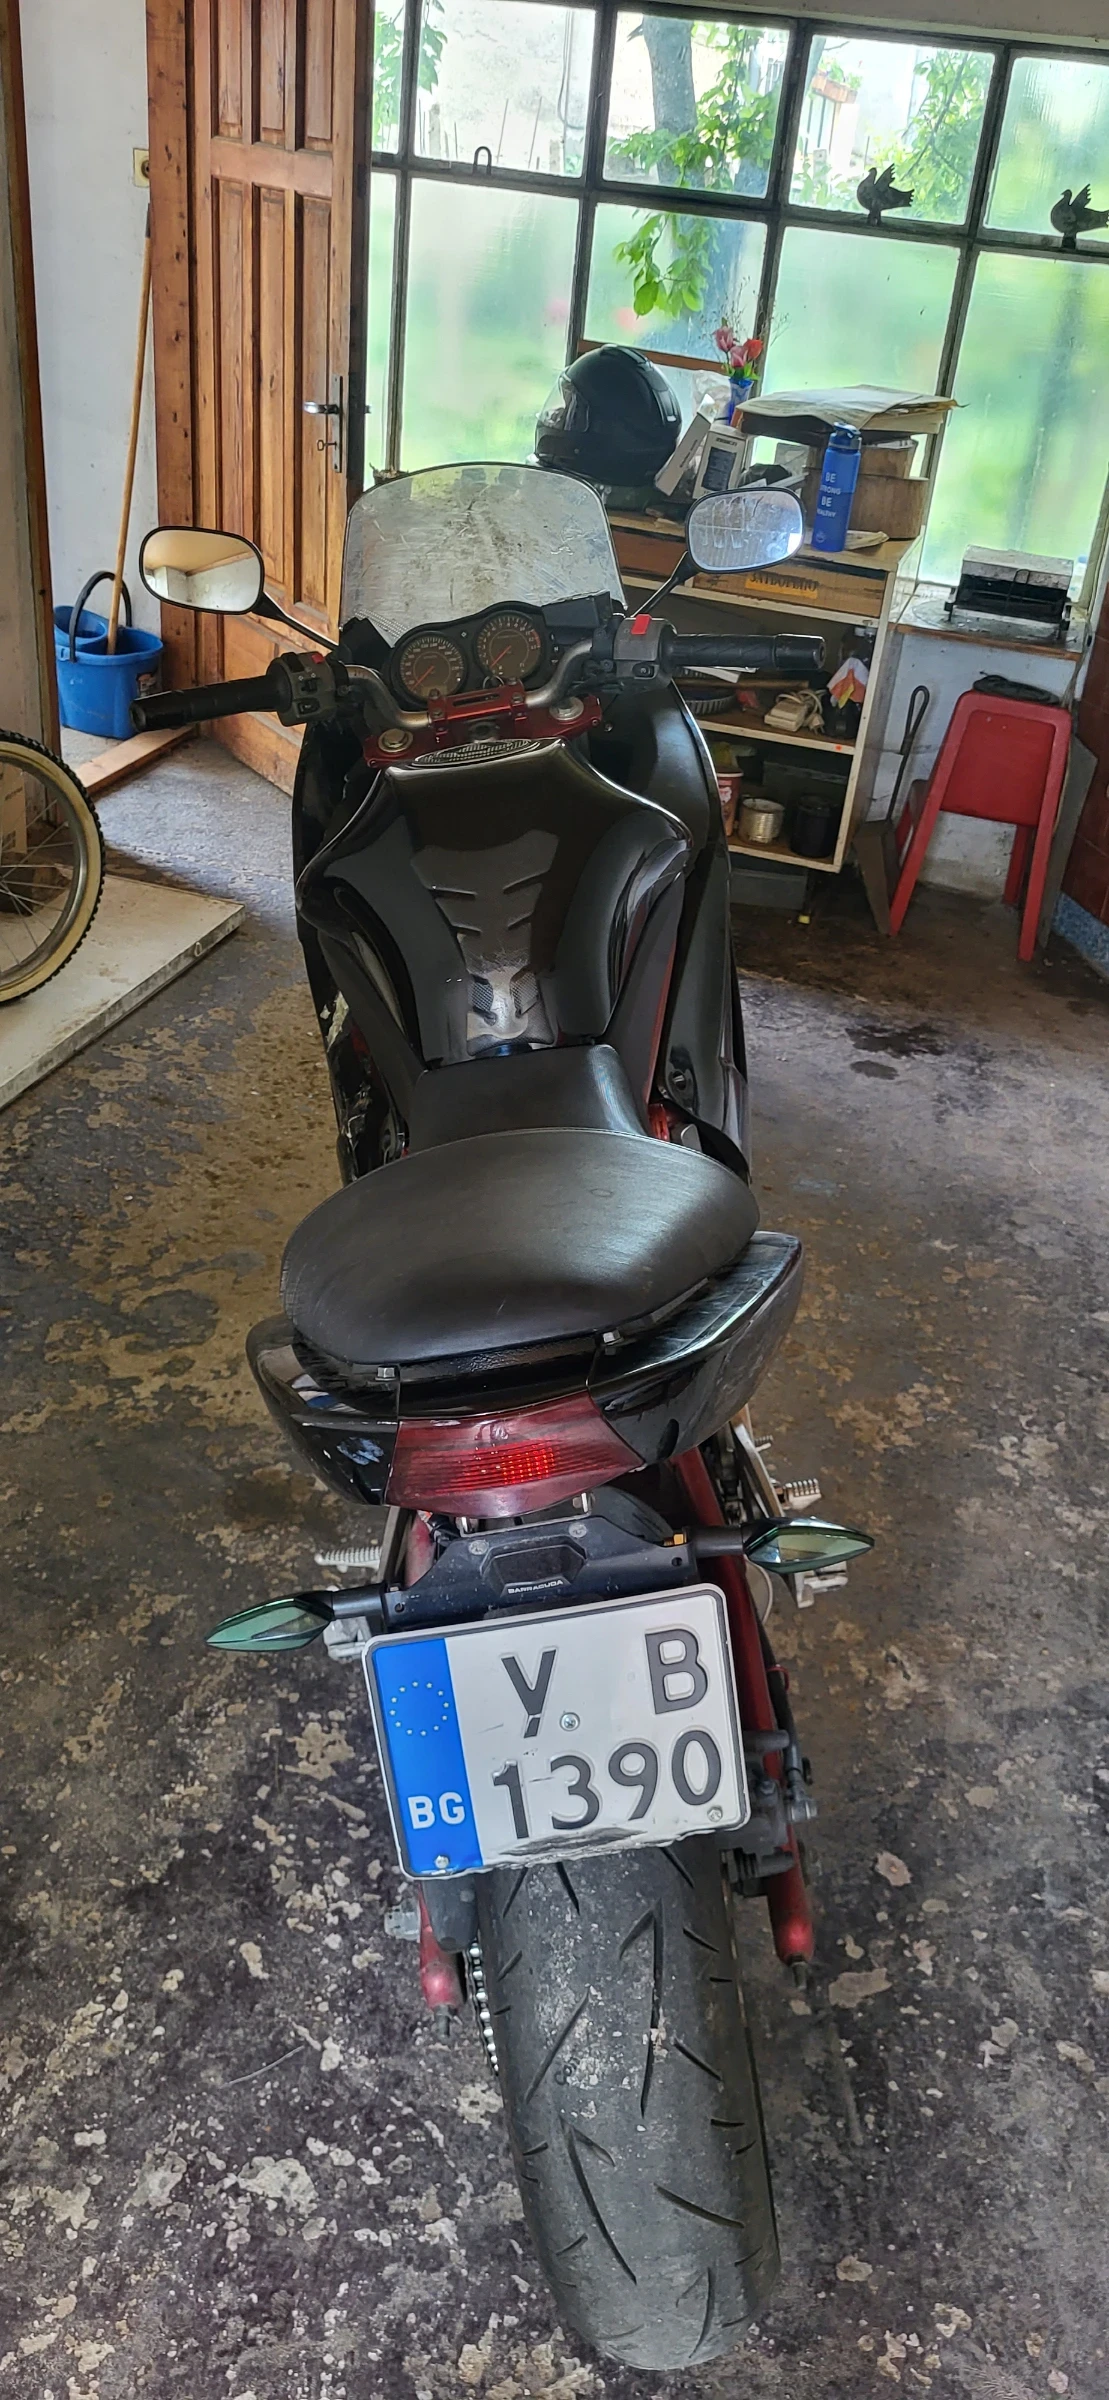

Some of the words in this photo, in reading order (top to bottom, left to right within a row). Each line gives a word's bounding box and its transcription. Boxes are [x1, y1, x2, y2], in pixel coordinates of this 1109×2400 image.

[826, 472, 836, 483] BE
[821, 496, 832, 507] BE
[507, 1580, 564, 1594] BARRACUDA
[644, 1628, 709, 1715] B
[493, 1729, 722, 1839] 1390
[407, 1791, 465, 1830] BG
